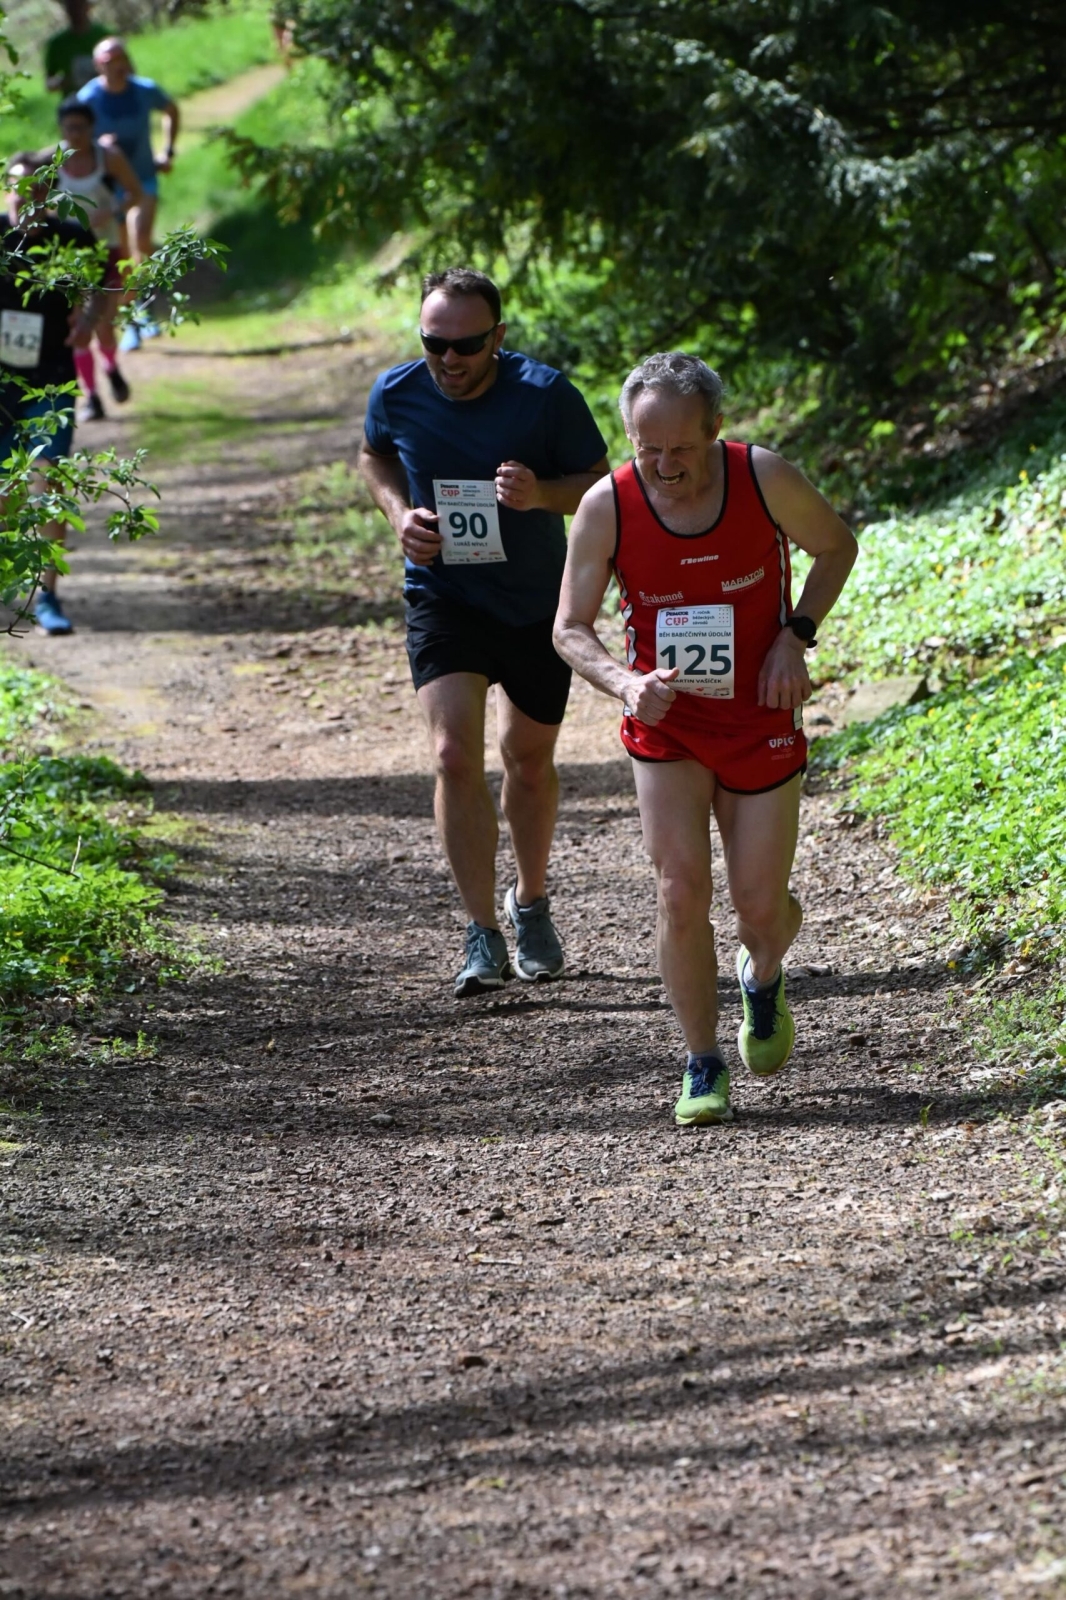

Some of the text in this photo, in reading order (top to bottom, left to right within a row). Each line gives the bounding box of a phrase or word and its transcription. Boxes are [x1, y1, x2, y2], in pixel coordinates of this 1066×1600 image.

[441, 489, 460, 497] CUP
[448, 511, 488, 539] 90
[721, 566, 765, 591] MARATON
[665, 616, 689, 626] CUP
[659, 644, 732, 676] 125
